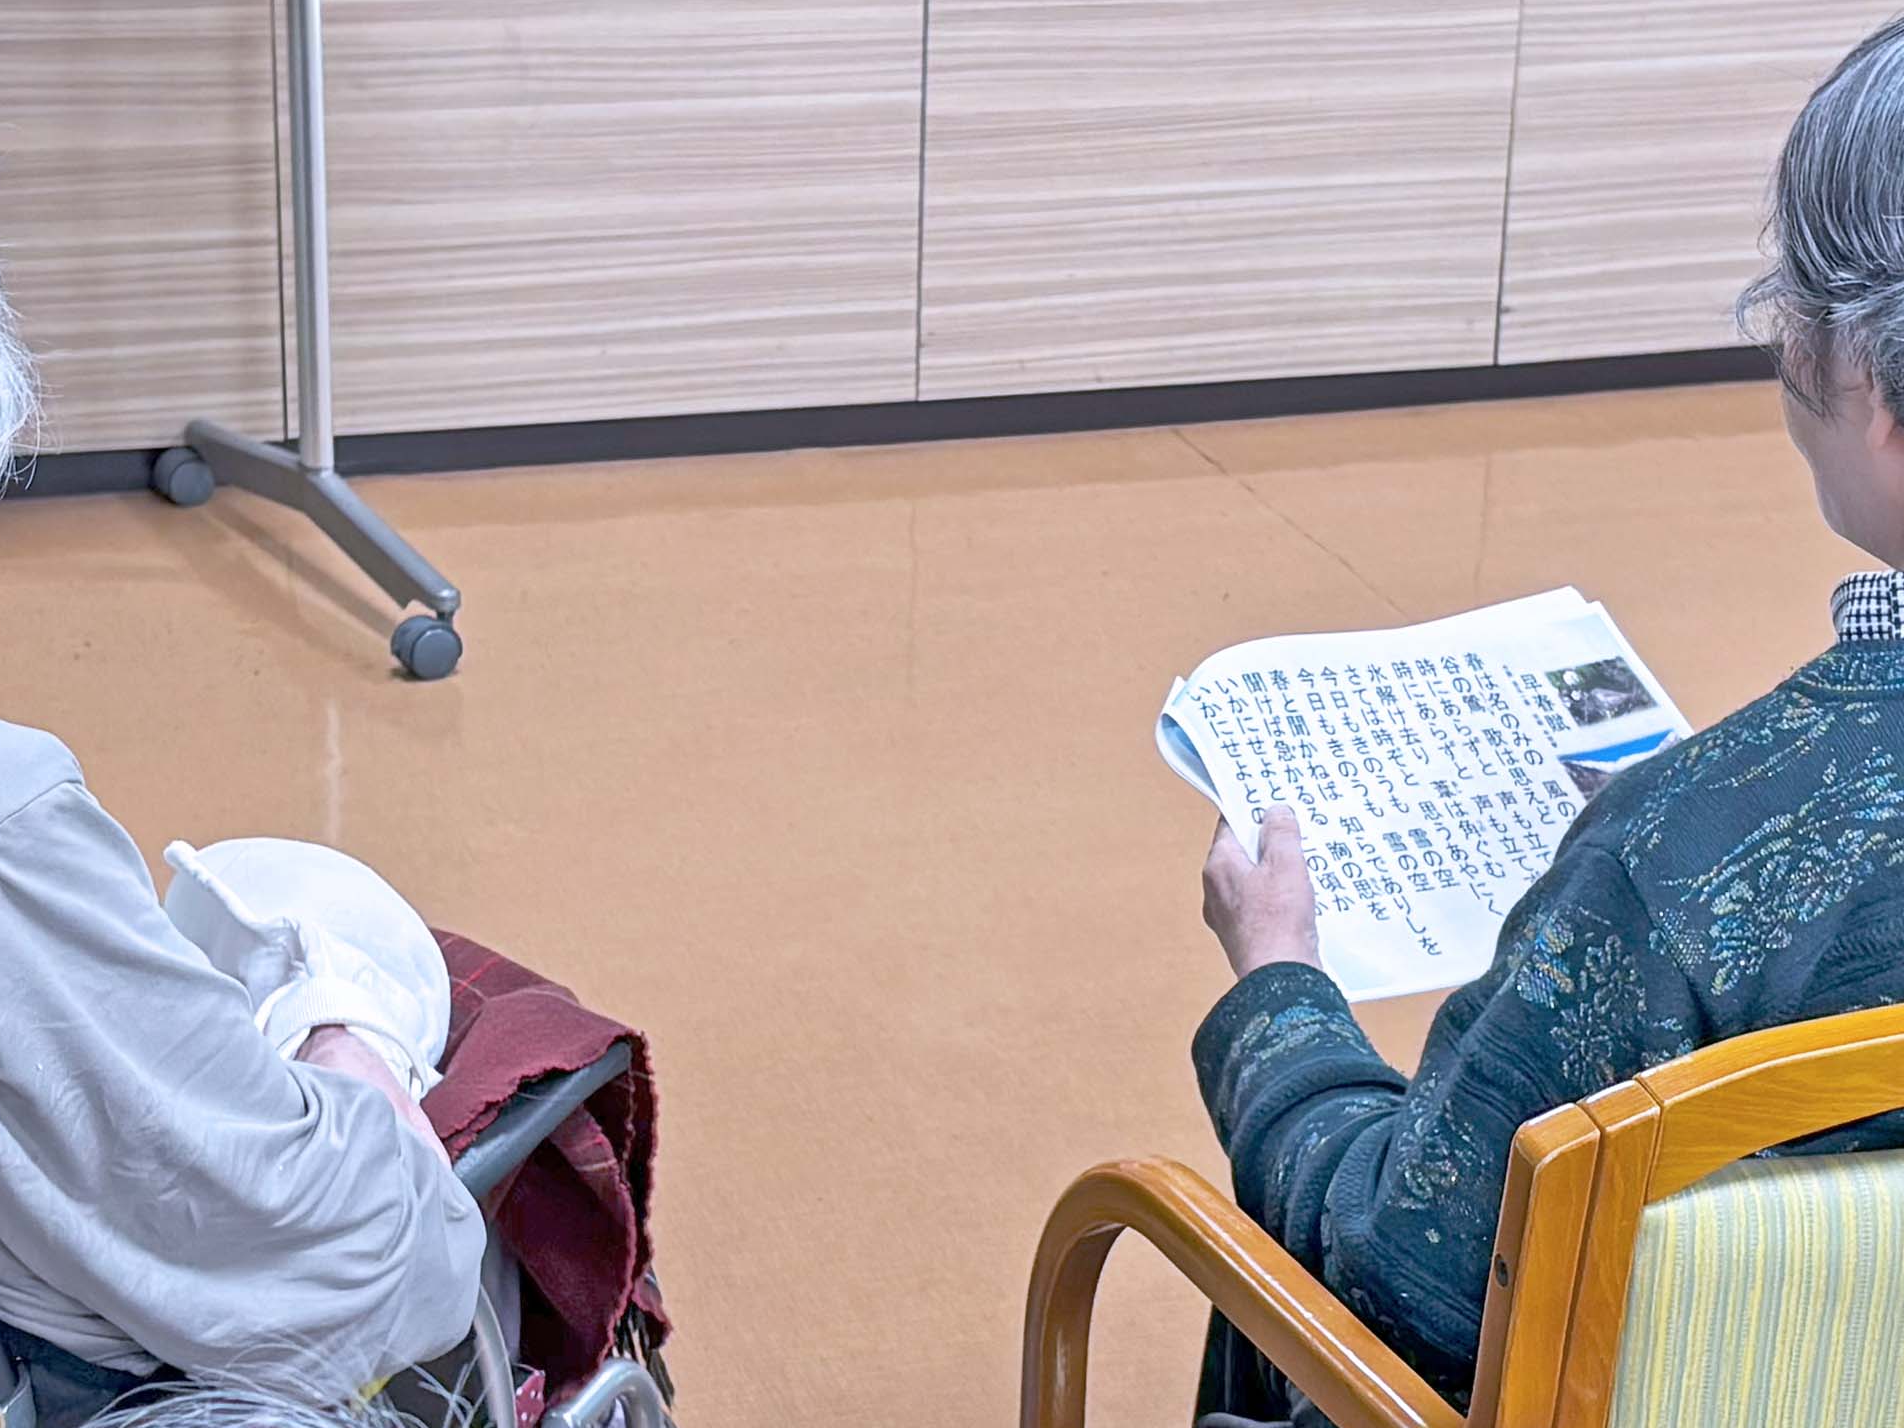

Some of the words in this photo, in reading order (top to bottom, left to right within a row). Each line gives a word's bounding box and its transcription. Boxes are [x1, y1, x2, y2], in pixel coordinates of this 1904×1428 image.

[1214, 677, 1287, 802] いかにせよと
[1241, 672, 1329, 826] 聞けば急かるる
[1320, 665, 1410, 814] 今日もきのうも
[1408, 828, 1461, 889] 雪の空
[1367, 663, 1429, 765] 氷解け去り
[1391, 661, 1473, 781] 時にあらずと
[1414, 657, 1499, 777] 時にあらずと
[1463, 651, 1544, 766] 春は名のみの
[1268, 669, 1344, 801] 春と聞かねば
[1339, 815, 1442, 956] 知らでありしを
[1297, 667, 1385, 818] 今日もきのうも
[1382, 832, 1435, 893] 雪の空
[1344, 664, 1420, 787] さては時ぞと
[1417, 800, 1505, 917] 思うあやにく
